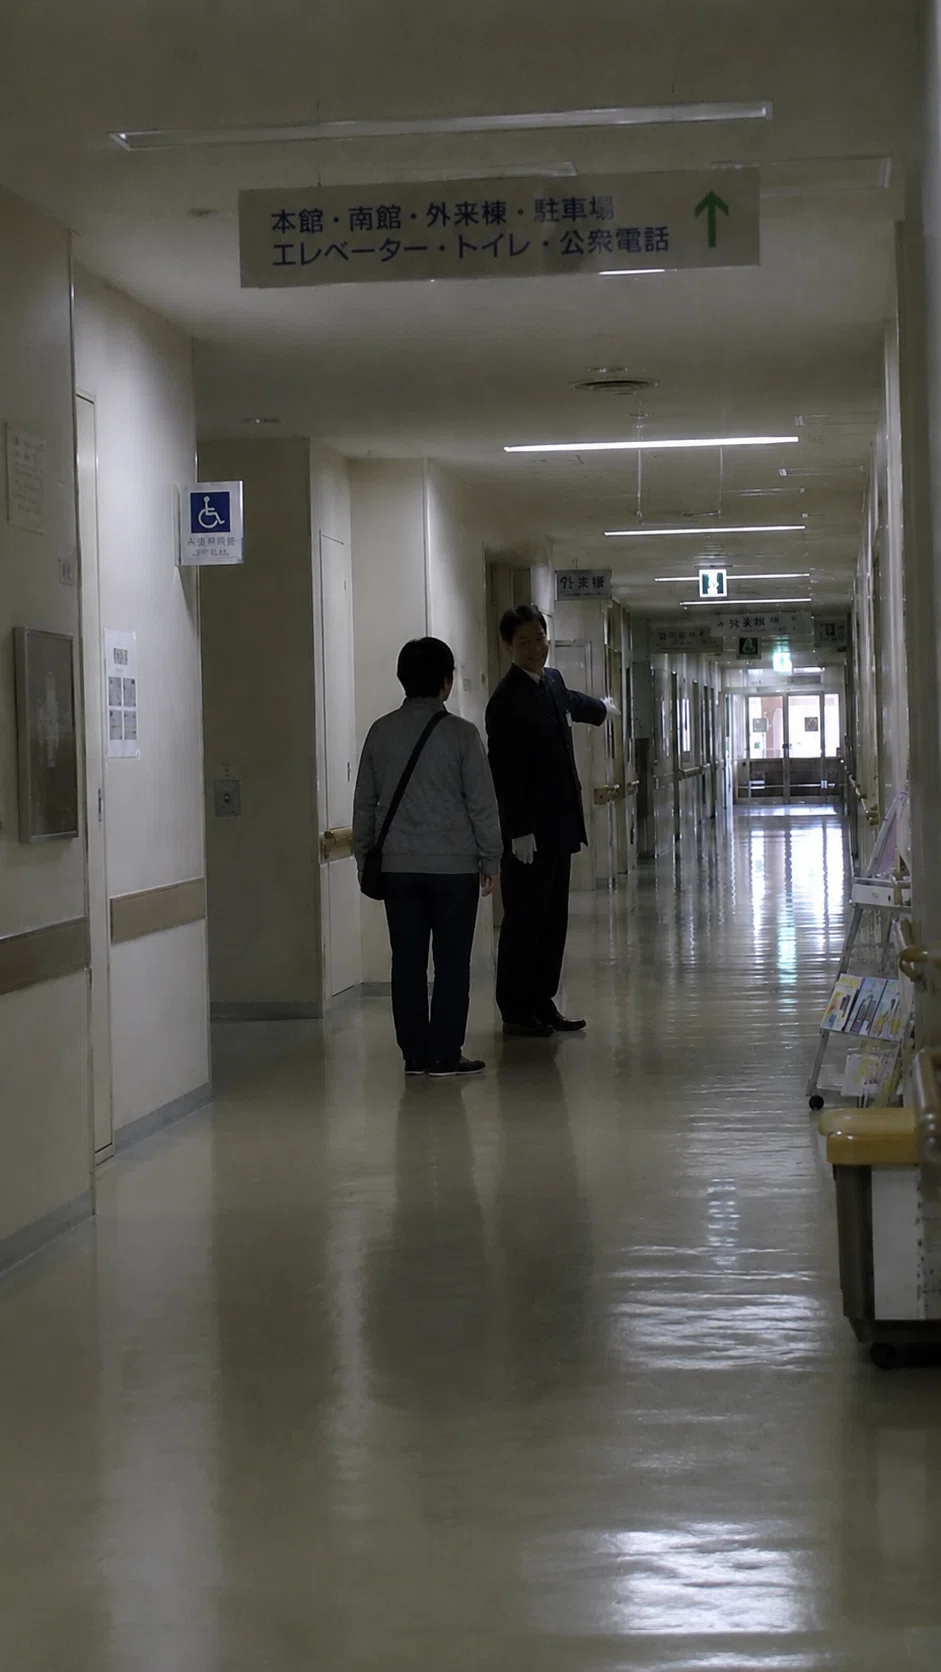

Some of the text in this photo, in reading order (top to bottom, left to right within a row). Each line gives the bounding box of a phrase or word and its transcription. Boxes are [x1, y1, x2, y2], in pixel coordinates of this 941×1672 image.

[272, 226, 670, 266] エレベーター・トイレ・公衆電話
